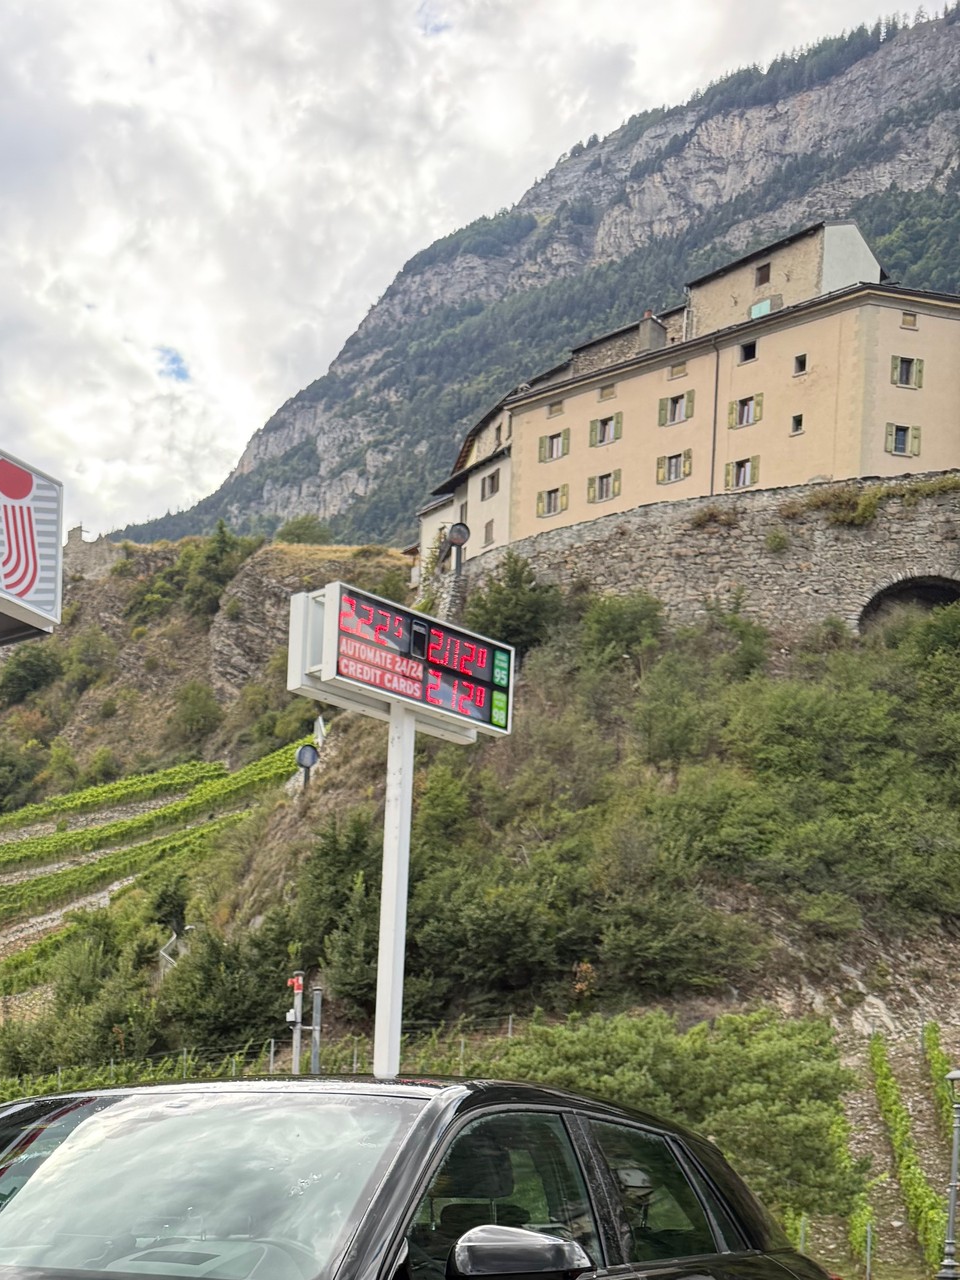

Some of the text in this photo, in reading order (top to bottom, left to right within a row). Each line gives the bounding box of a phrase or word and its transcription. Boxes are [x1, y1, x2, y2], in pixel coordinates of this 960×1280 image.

[340, 638, 424, 680] AUTOMATE 24/24
[341, 658, 421, 697] CREDIT CARDS
[494, 668, 508, 685] 95
[492, 708, 506, 724] 98
